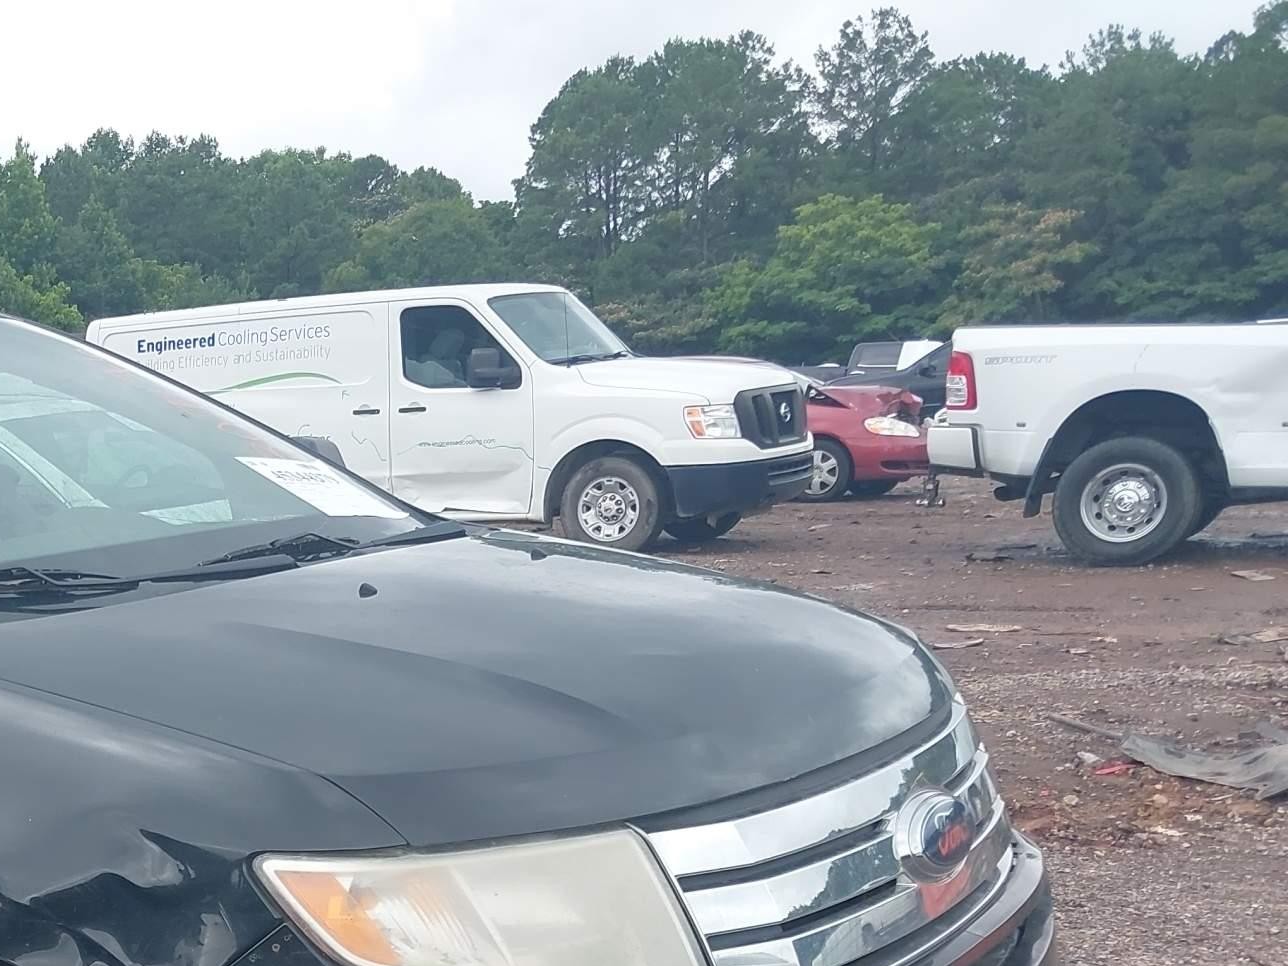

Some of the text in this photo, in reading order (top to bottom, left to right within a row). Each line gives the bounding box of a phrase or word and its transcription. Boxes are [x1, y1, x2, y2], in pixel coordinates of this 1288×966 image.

[137, 324, 330, 355] Engineered Cooling Services
[142, 344, 331, 373] ilding Efficiency and Sustainability
